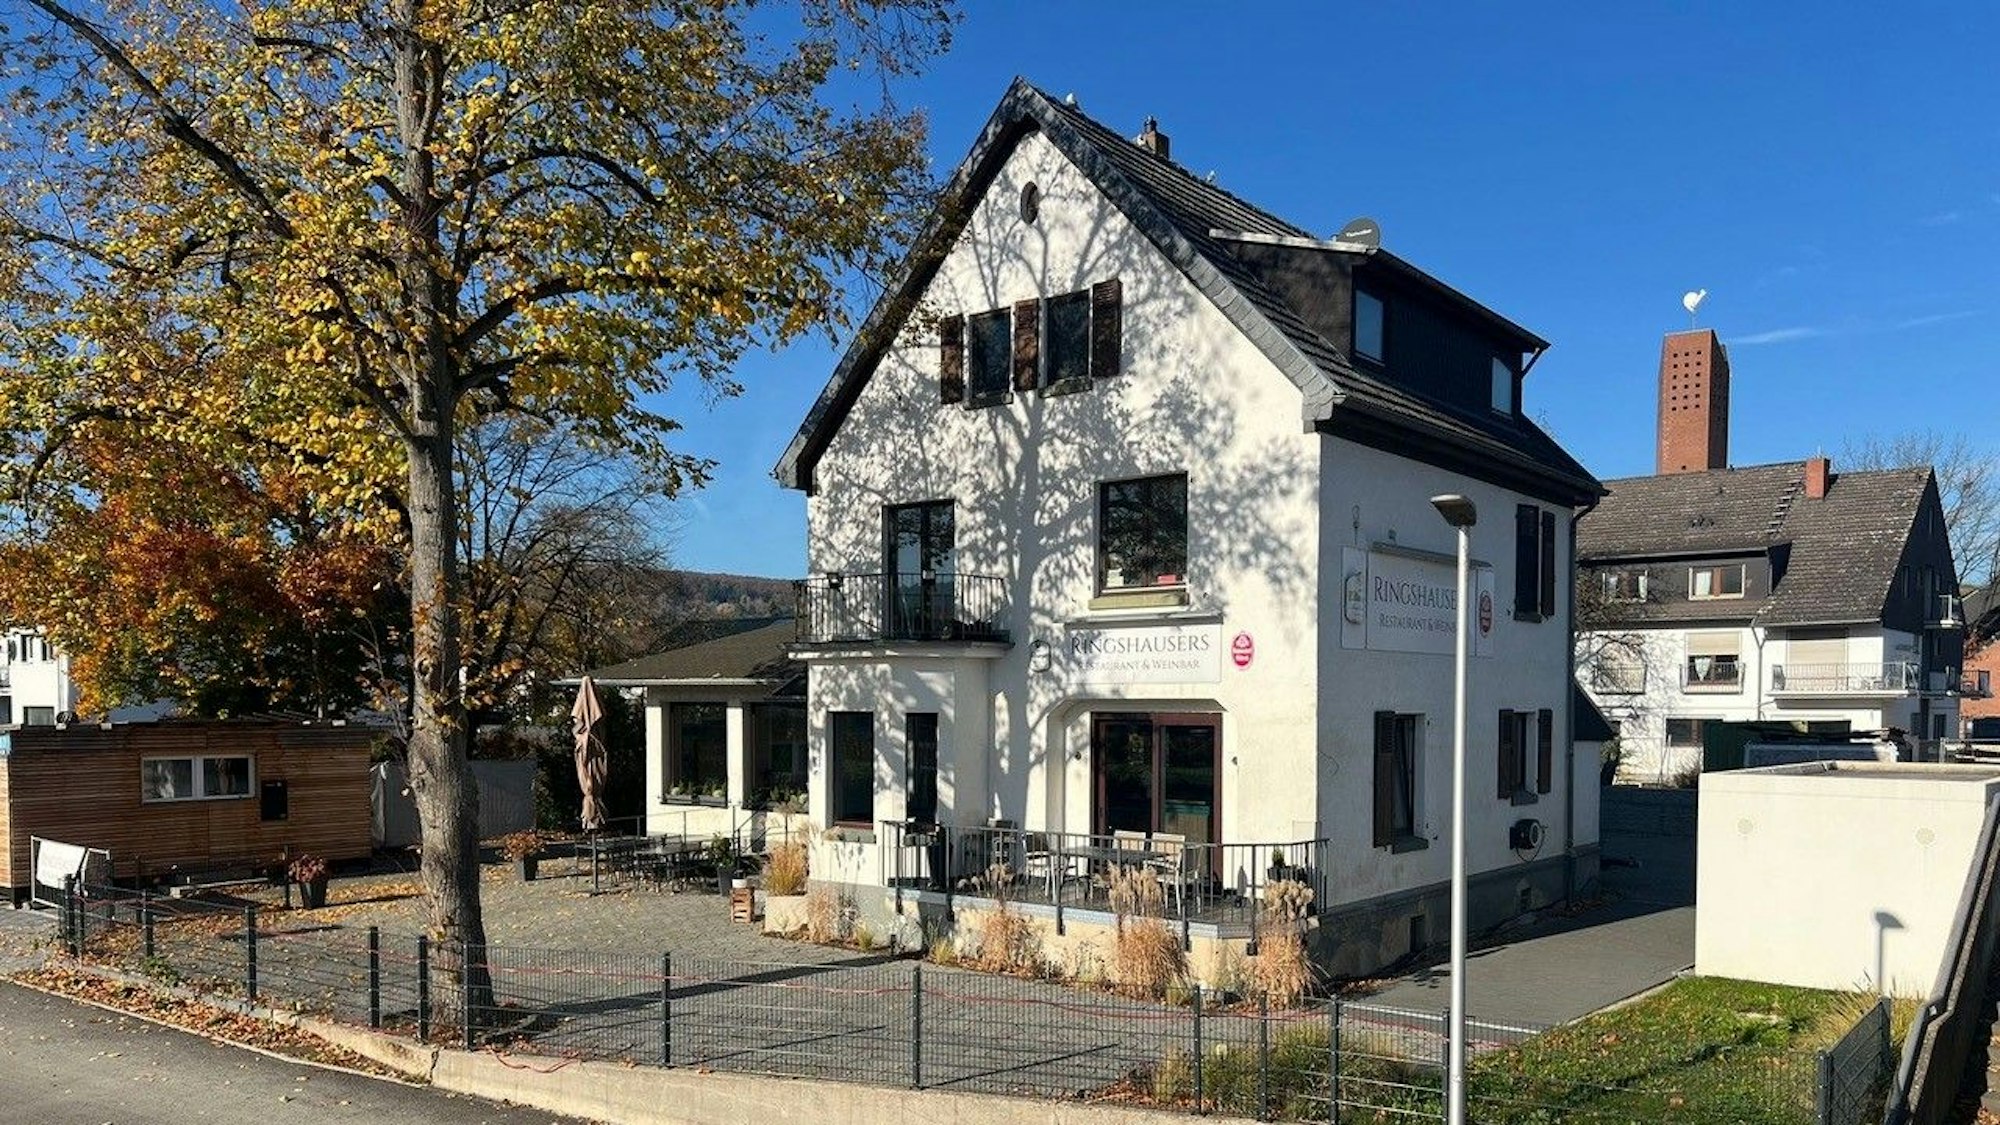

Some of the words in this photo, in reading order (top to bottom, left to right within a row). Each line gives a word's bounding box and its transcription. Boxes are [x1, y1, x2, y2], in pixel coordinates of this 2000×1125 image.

[1374, 576, 1457, 610] RINGSHAUSE
[1071, 634, 1209, 654] RINGSHAUSERS
[1151, 658, 1201, 670] WEINBAR
